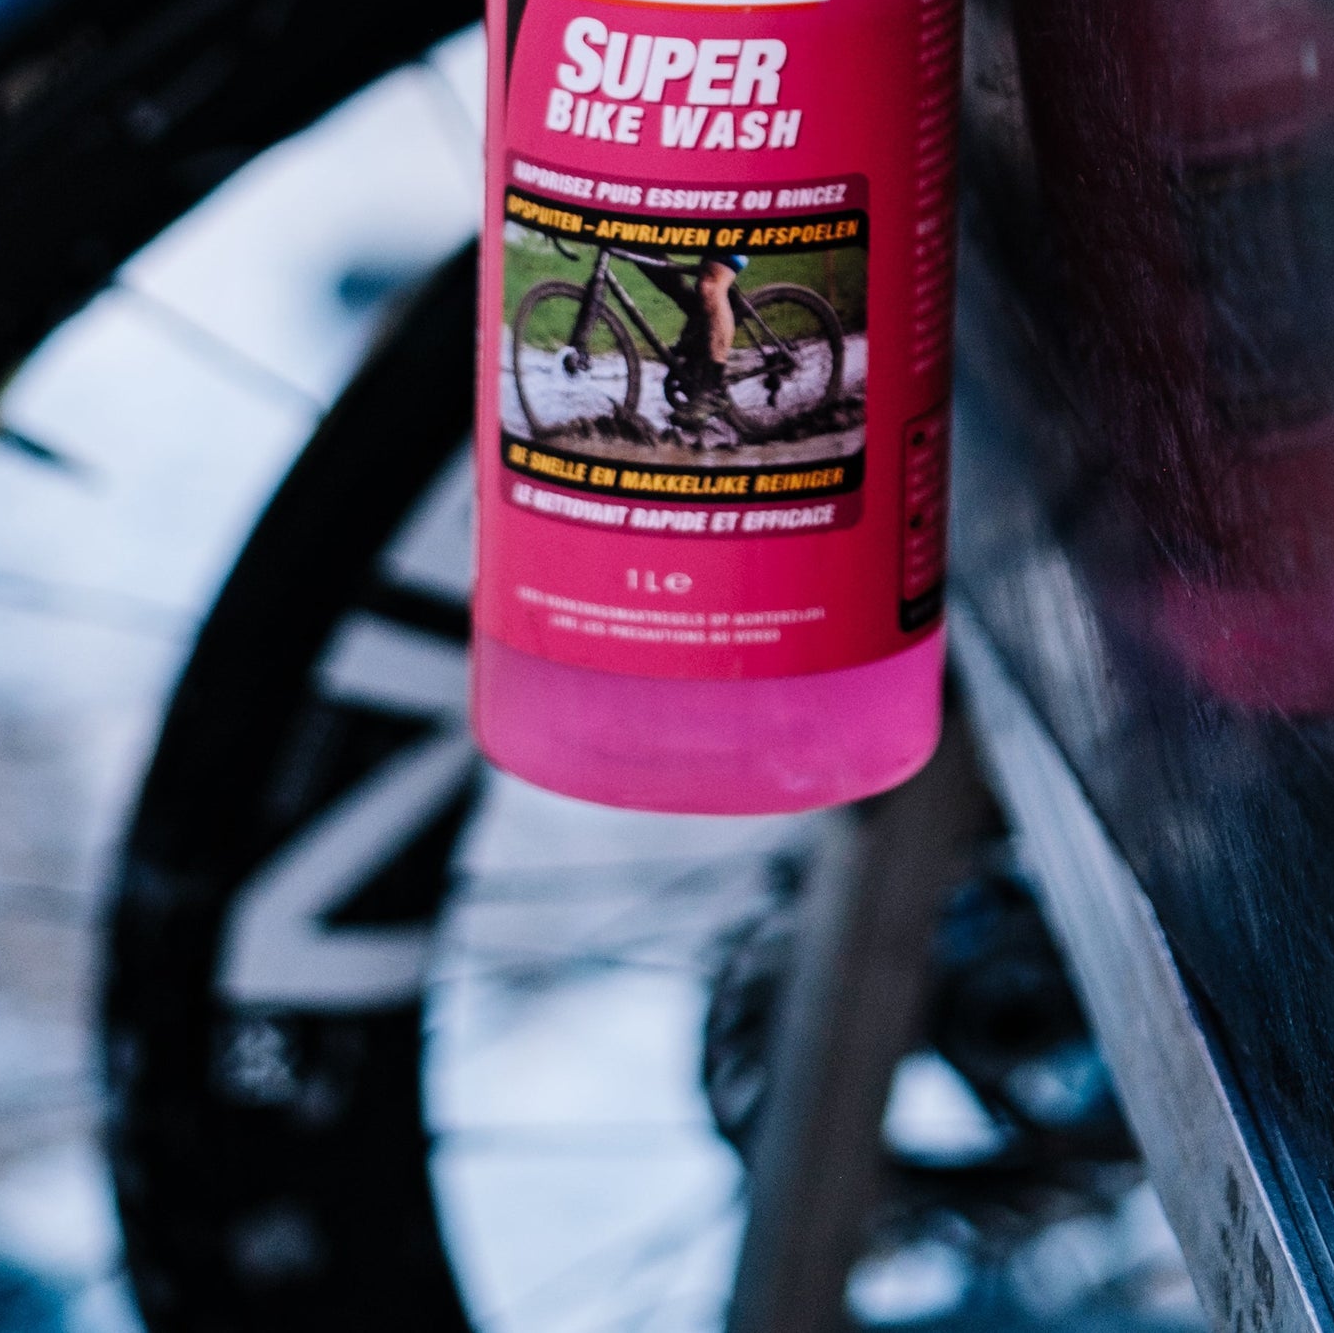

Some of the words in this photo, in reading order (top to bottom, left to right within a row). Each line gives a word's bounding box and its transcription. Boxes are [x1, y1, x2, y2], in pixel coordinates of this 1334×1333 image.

[557, 17, 787, 106] SUPER
[545, 88, 645, 145] BIKE
[661, 108, 801, 150] WASH
[595, 181, 643, 205] PUIS
[645, 187, 739, 210] ESSUYEZ
[741, 190, 772, 210] OU
[776, 183, 847, 209] RINCEZ
[715, 227, 744, 247] OF
[748, 219, 859, 247] AFSPOELEN
[588, 465, 617, 487] EN
[619, 470, 750, 495] MAKKELIJKE
[629, 507, 709, 533] RAPIDE
[710, 511, 740, 533] ET
